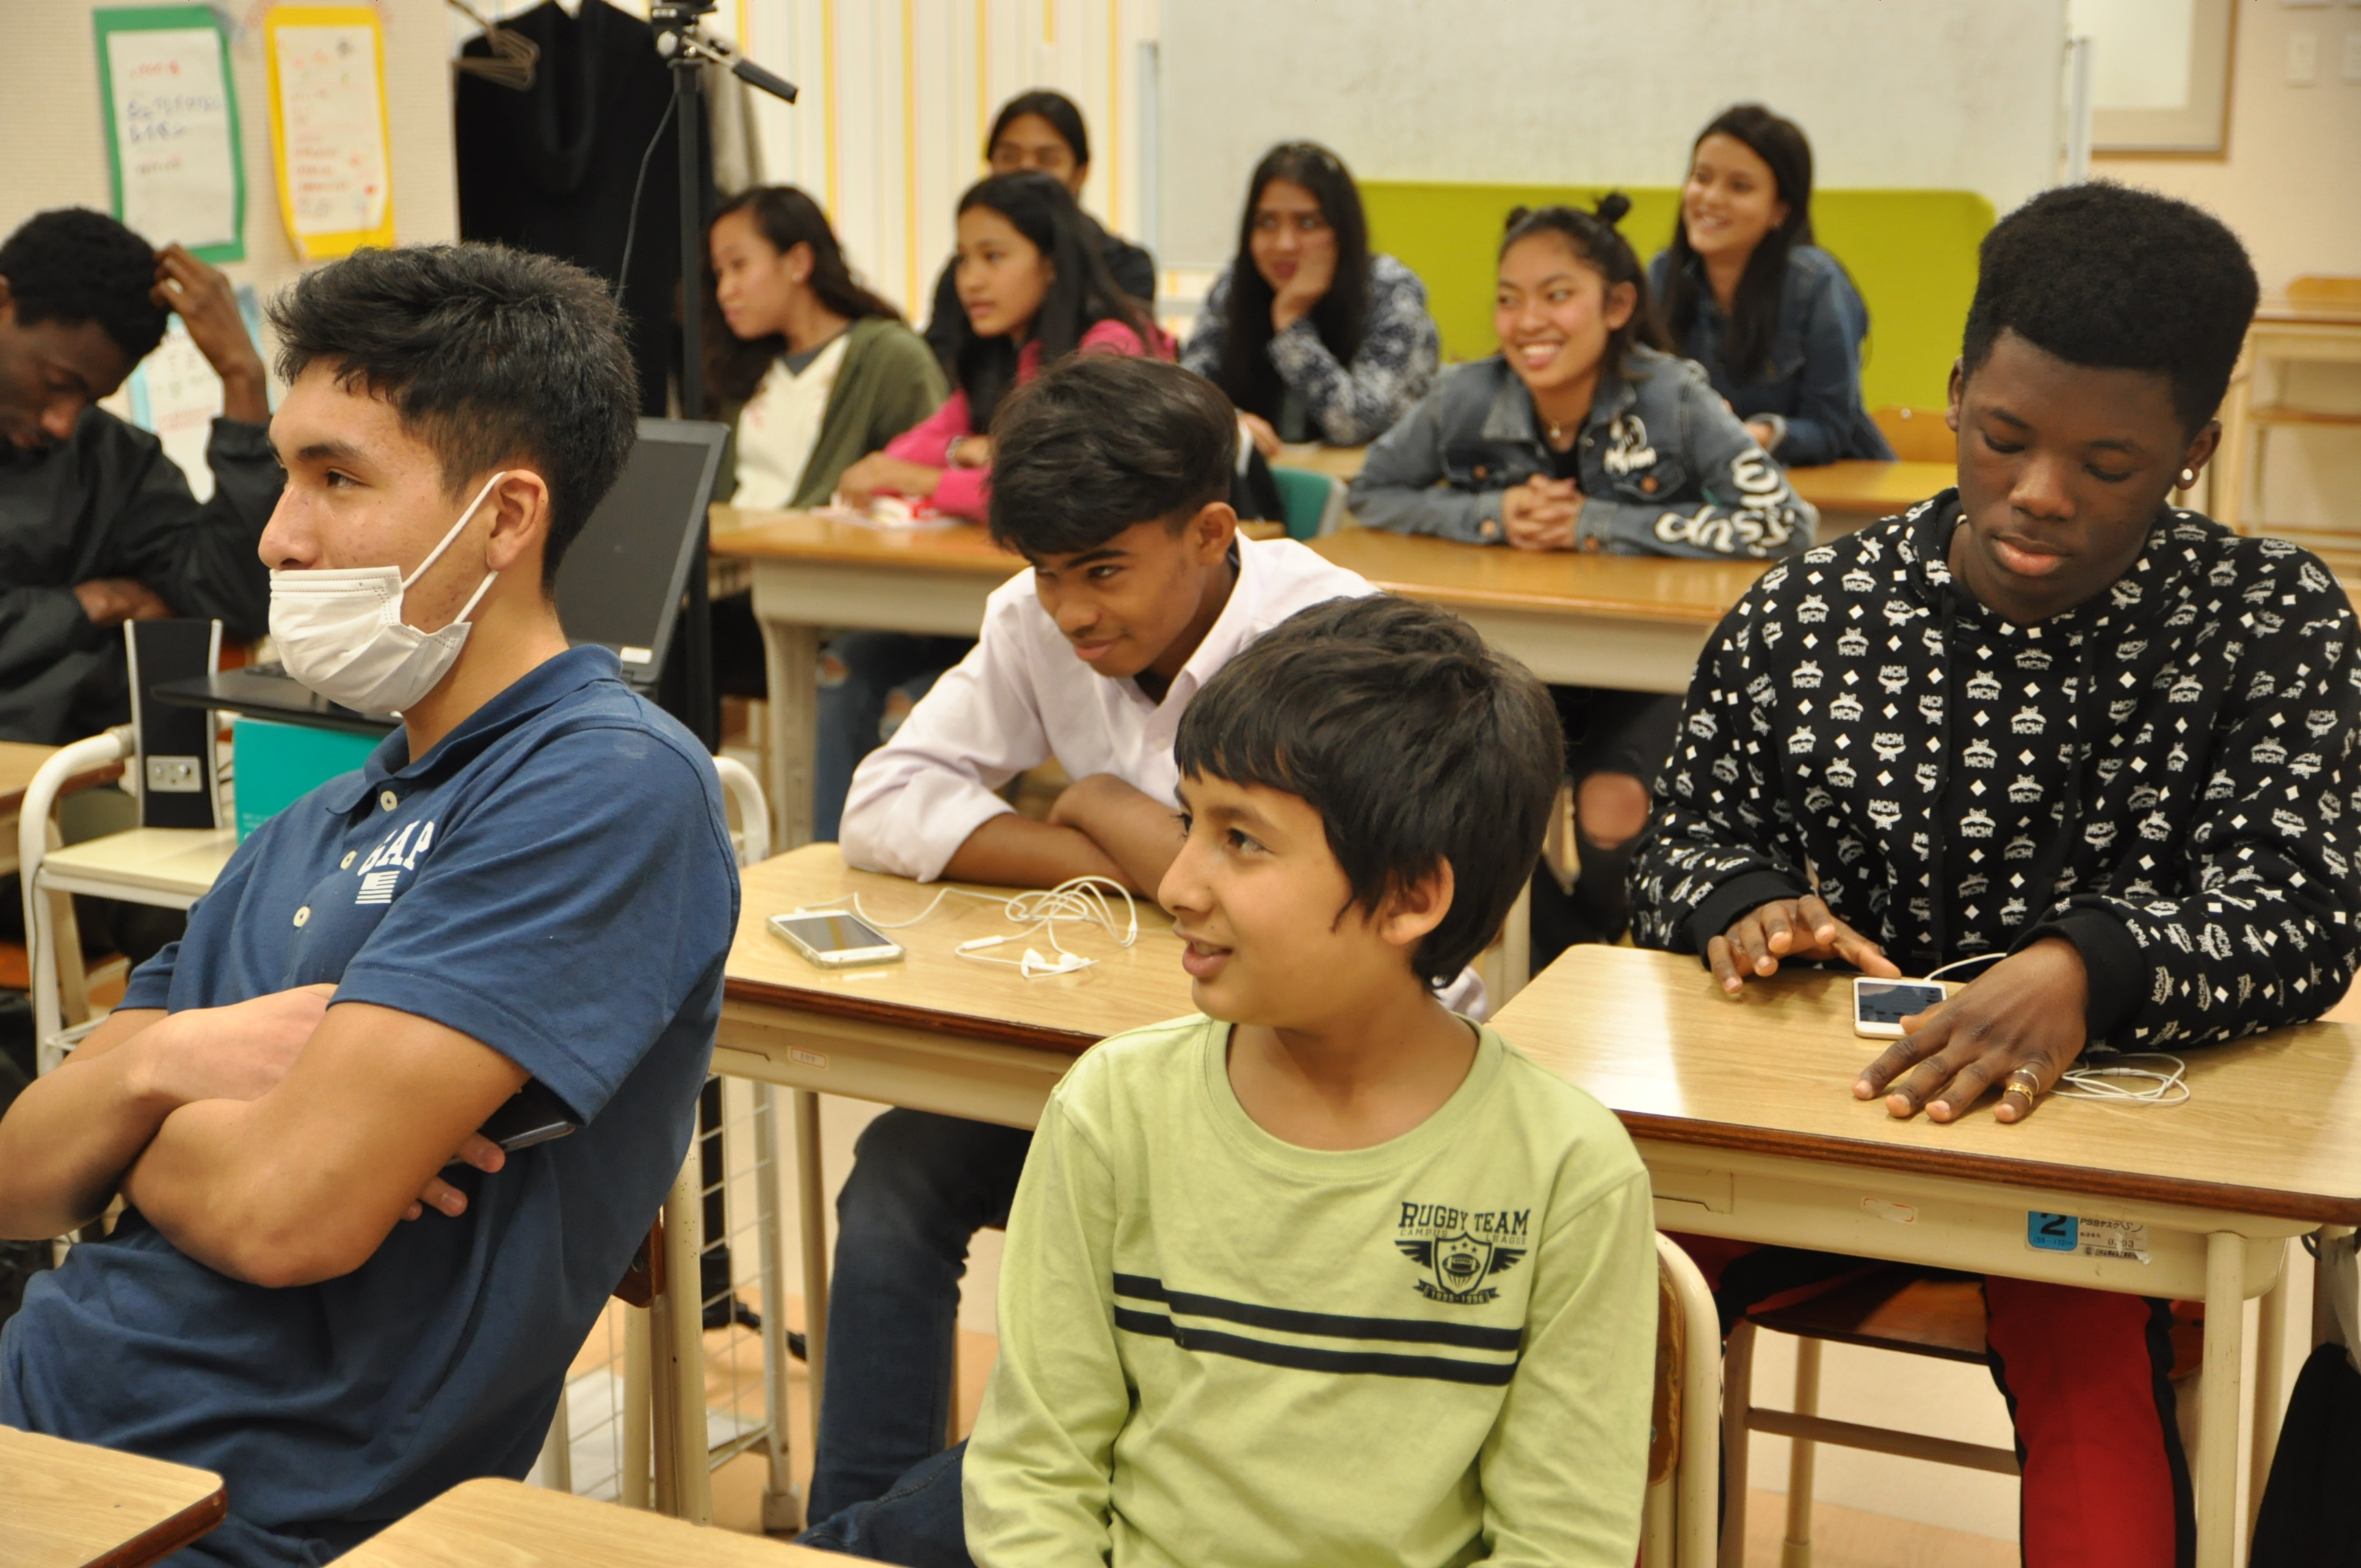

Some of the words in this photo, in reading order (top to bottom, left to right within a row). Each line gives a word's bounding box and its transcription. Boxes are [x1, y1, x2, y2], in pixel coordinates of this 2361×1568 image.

[357, 820, 435, 876] GAP
[1399, 1202, 1469, 1231] RUGBY
[1474, 1209, 1531, 1236] TEAM
[2040, 1213, 2067, 1236] 2
[1400, 1228, 1448, 1238] CAMPUS
[1485, 1234, 1527, 1246] LEAGUE
